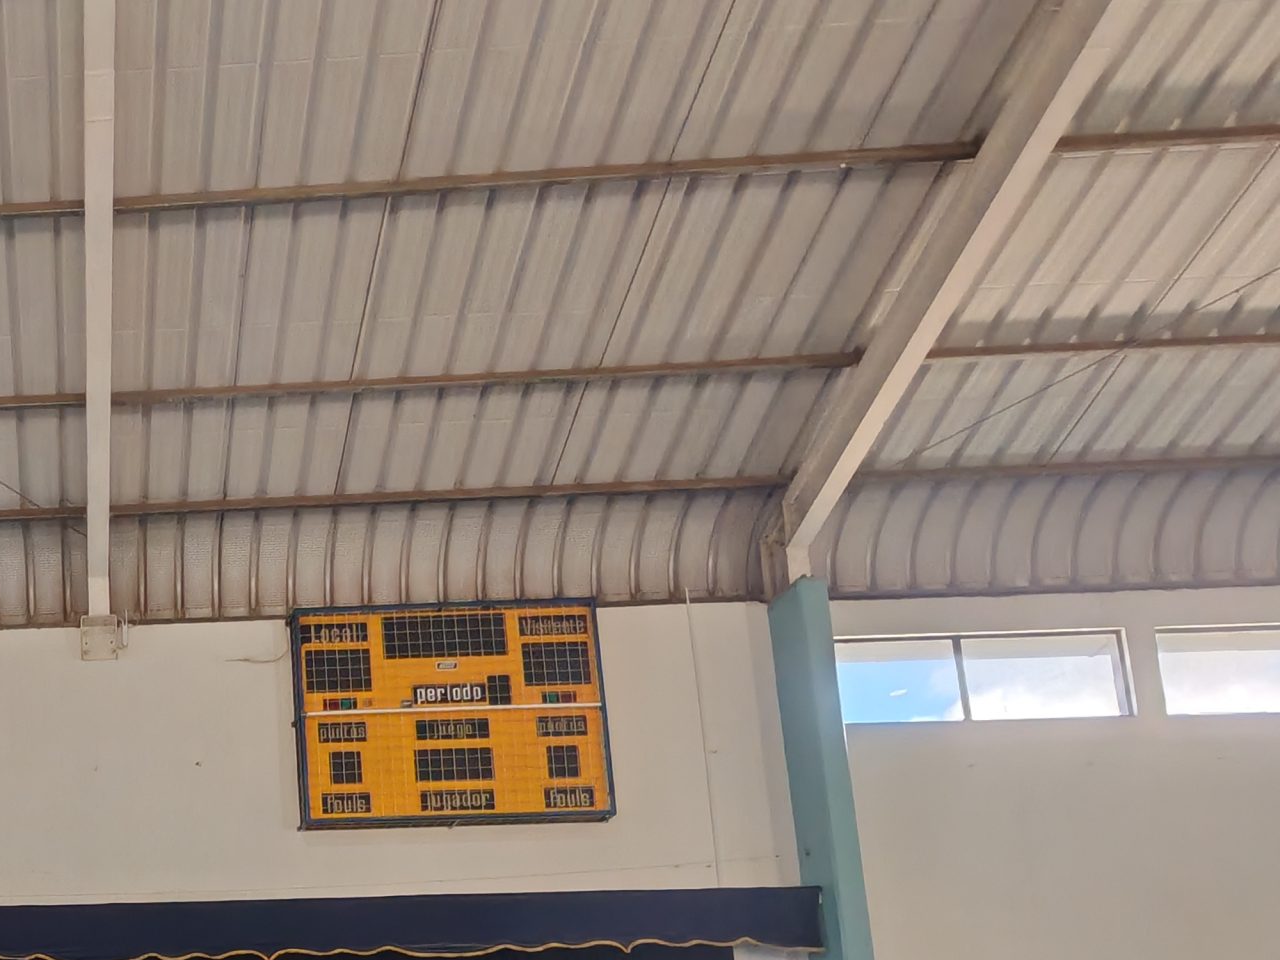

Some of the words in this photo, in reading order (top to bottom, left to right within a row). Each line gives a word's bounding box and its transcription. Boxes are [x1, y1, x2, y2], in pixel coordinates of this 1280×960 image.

[310, 624, 357, 644] Local
[416, 684, 482, 704] periodo
[433, 723, 473, 739] juego
[327, 794, 366, 813] fouls
[427, 792, 491, 812] jugador
[550, 789, 590, 807] fouls
